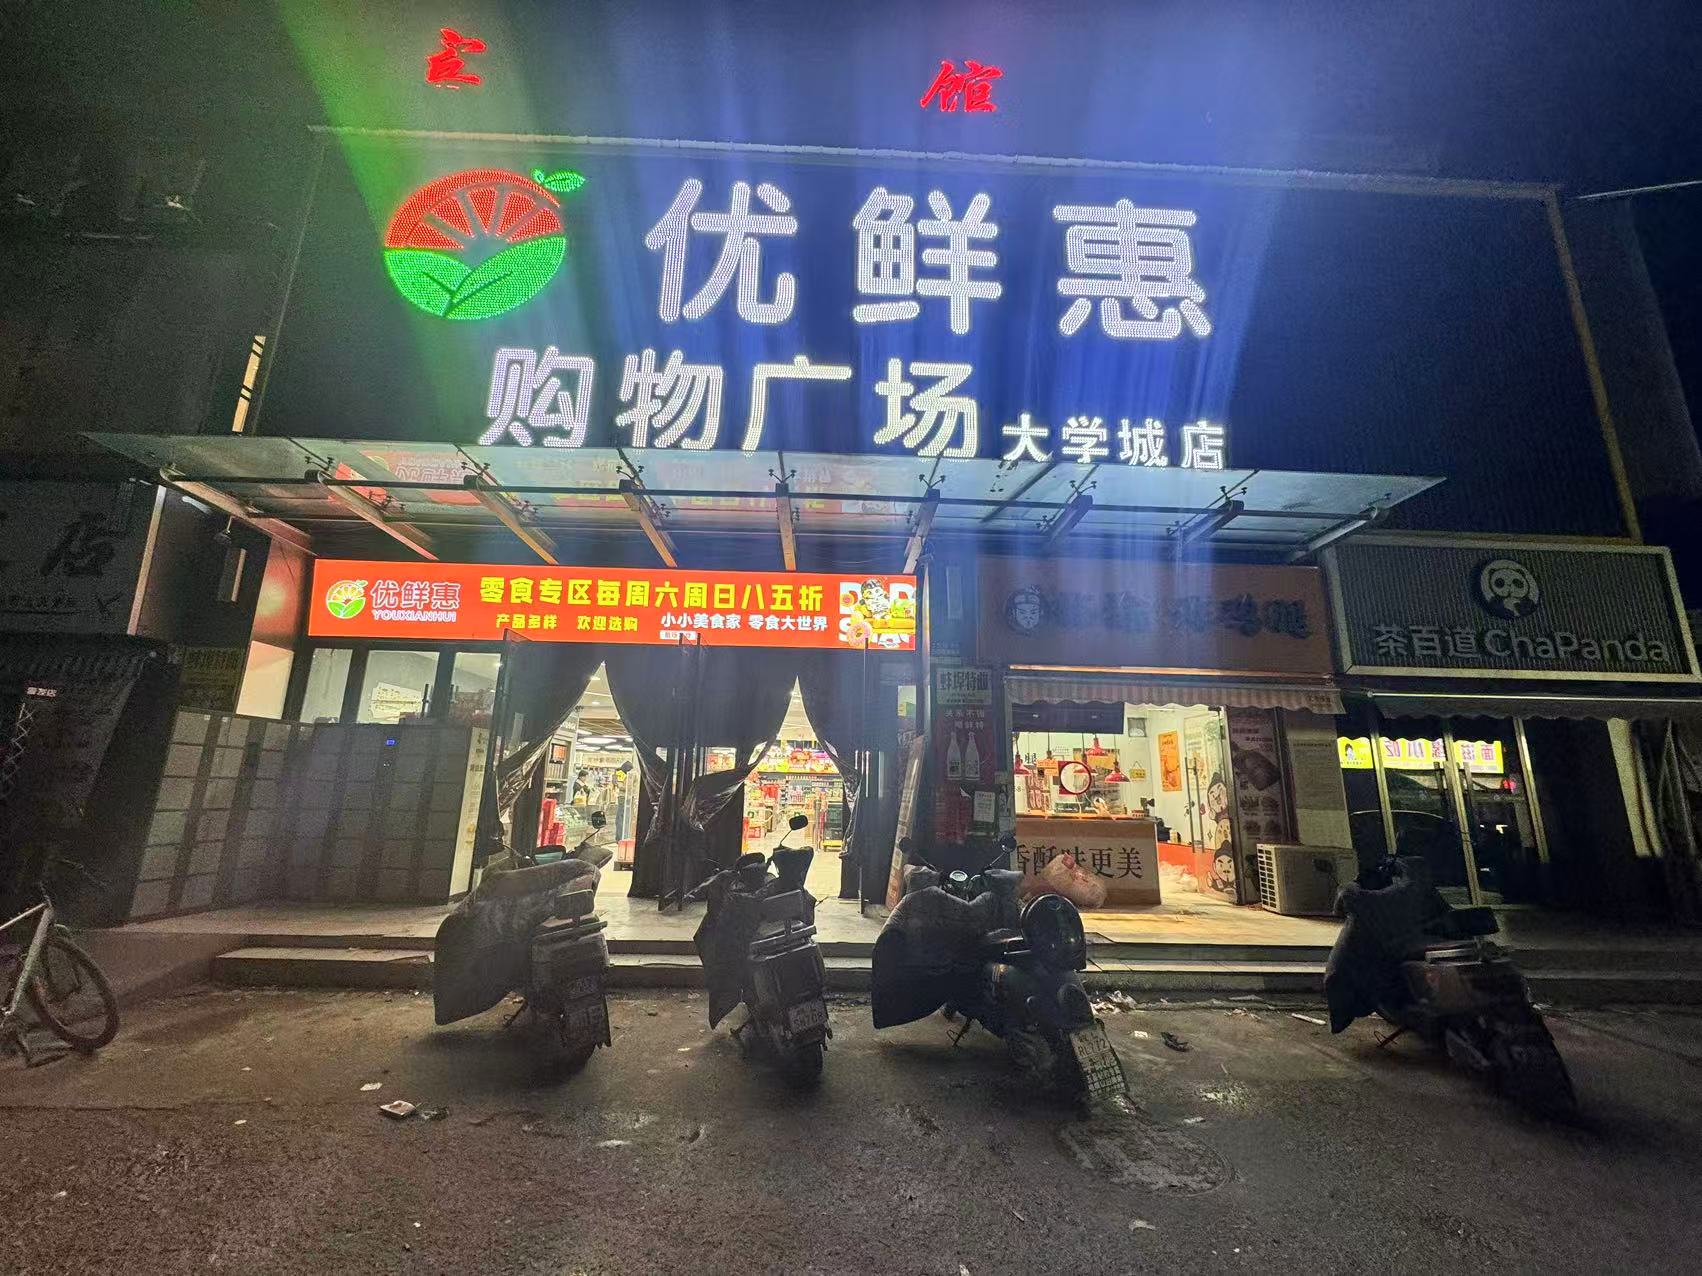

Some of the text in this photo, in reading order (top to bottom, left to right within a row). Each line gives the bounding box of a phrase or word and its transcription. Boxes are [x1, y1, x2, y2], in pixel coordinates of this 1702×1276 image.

[920, 58, 1003, 113] 馆
[645, 178, 1211, 339] 优鲜惠
[479, 345, 1225, 471] 购物广场 大学城店
[370, 579, 461, 610] 优鲜惠
[480, 576, 823, 612] 零食专区每周六周日八五折
[371, 609, 457, 622] YOUXIANHUI
[496, 614, 638, 631] 产品多样 欢迎选购
[661, 612, 828, 632] 小小美食家 零食大世界
[1374, 624, 1669, 662] 茶百道 ChaPanda
